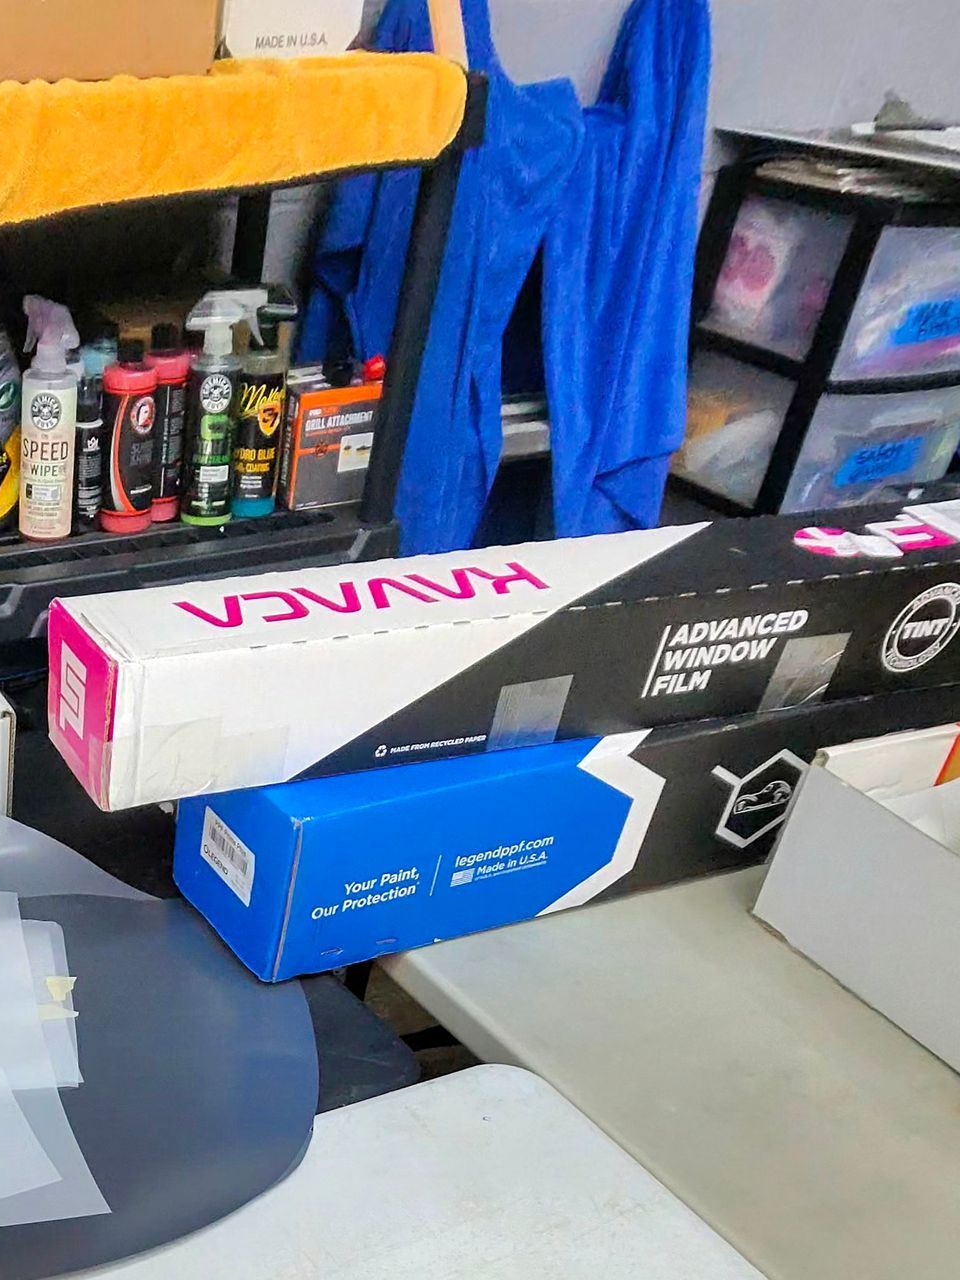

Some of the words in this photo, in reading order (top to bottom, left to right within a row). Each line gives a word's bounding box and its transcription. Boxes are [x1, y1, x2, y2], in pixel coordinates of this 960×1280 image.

[255, 36, 284, 49] MADE
[287, 35, 297, 47] IN
[305, 417, 326, 432] DRILL
[23, 438, 69, 461] SPEED
[30, 464, 59, 477] WIPE
[172, 561, 550, 628] KAVACA
[668, 609, 809, 647] ADVANCED
[902, 618, 951, 640] TINT
[663, 637, 777, 672] WINDOW
[651, 669, 712, 697] FILM
[389, 744, 410, 754] MADE
[410, 741, 430, 751] FROM
[431, 737, 465, 748] RECYCLED
[465, 734, 487, 744] PAPER
[454, 836, 555, 868] legendppf.com
[476, 862, 506, 876] Made
[507, 858, 518, 869] in
[519, 850, 549, 866] U.S.A.
[344, 877, 378, 896] Your
[380, 866, 420, 888] Paint,
[311, 904, 340, 920] Our
[341, 885, 416, 912] Protection
